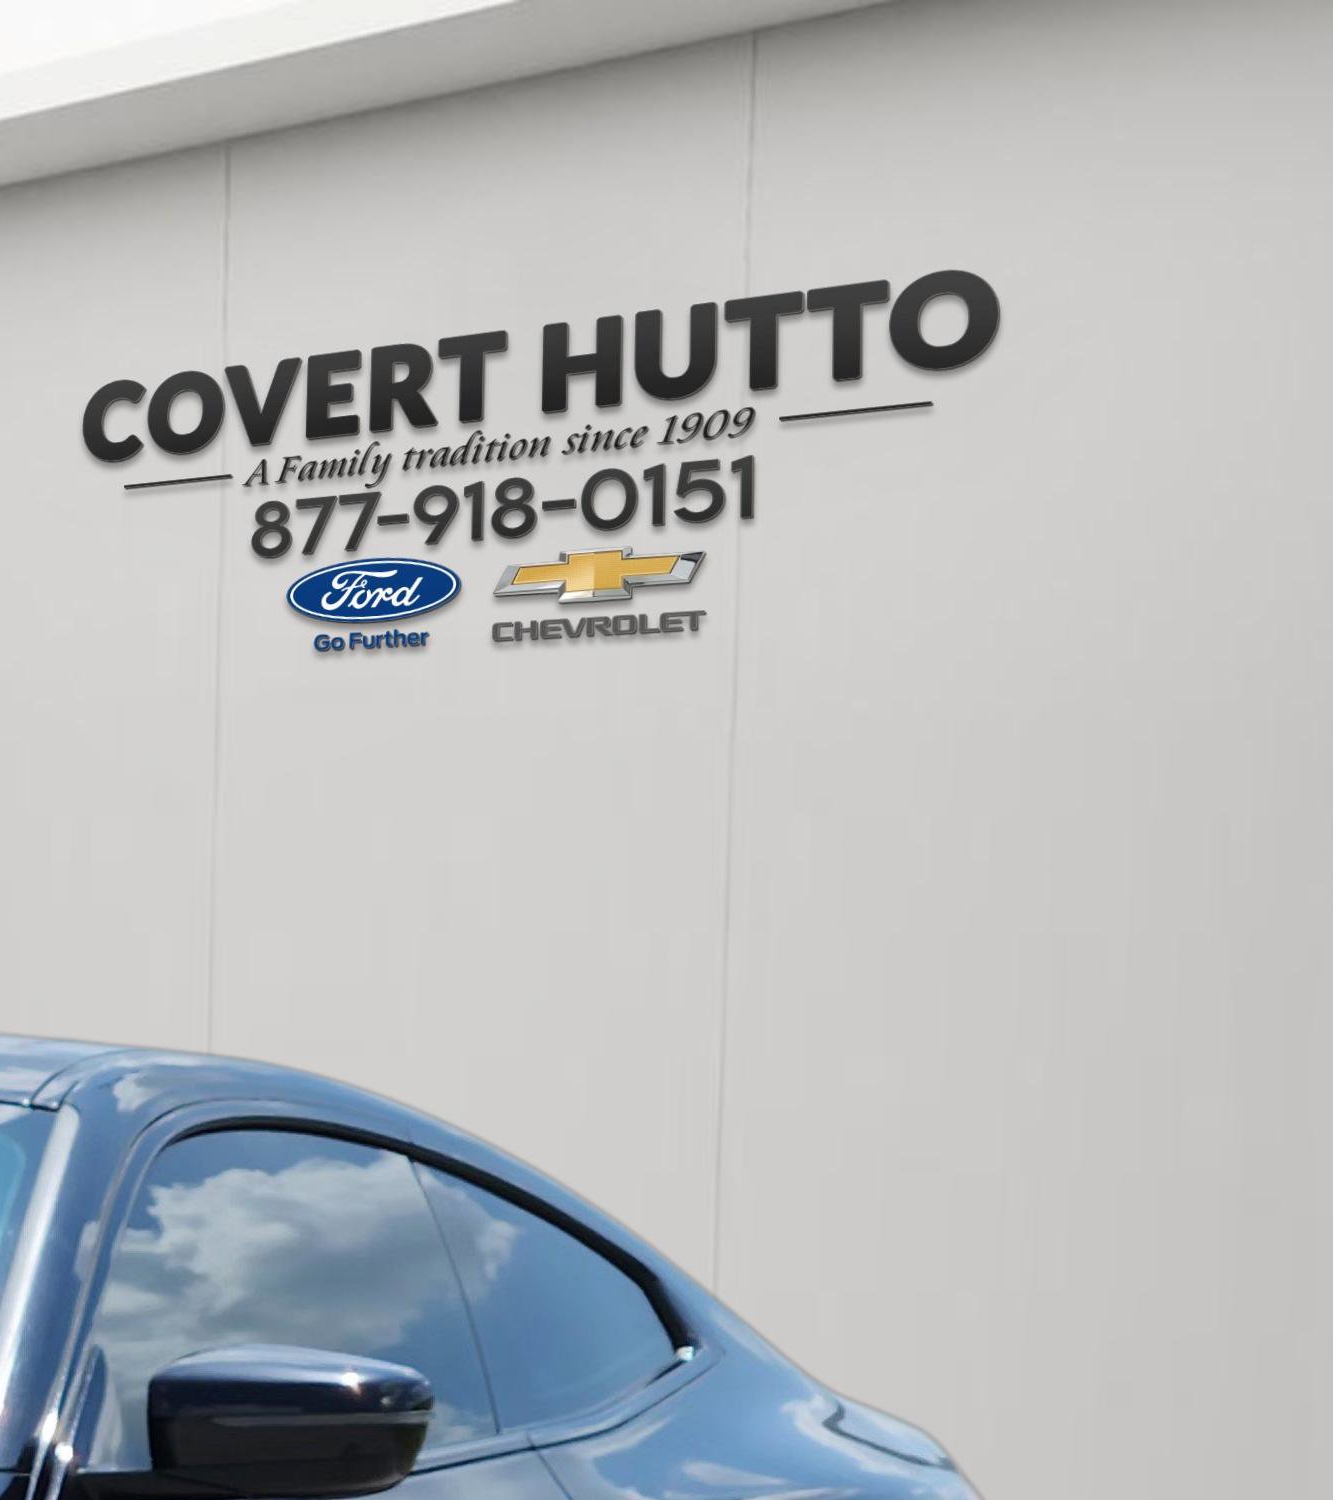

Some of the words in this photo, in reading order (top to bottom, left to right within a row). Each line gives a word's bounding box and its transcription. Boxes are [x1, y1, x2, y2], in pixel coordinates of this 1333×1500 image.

[81, 329, 509, 465] COVERT
[540, 268, 1001, 415] HUTTO
[243, 457, 270, 488] A
[275, 441, 392, 489] Family
[402, 429, 553, 473] tradition
[561, 423, 649, 457] since
[656, 406, 757, 446] 1909
[250, 455, 756, 560] 877-918-0151
[321, 568, 424, 612] Ford
[313, 632, 346, 654] Go
[348, 629, 431, 652] Further
[491, 609, 708, 644] CHEVROLET
